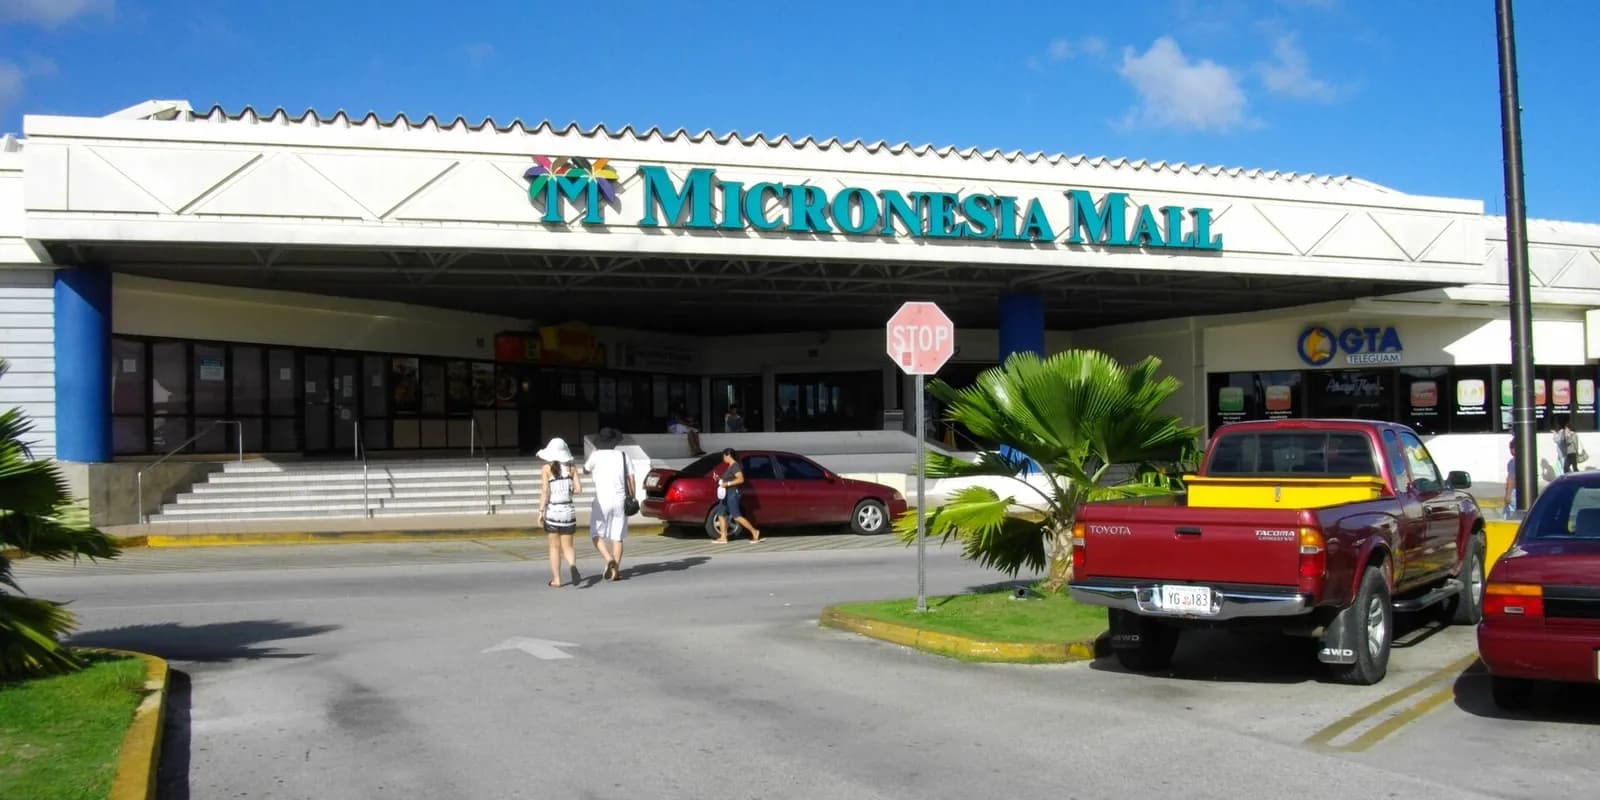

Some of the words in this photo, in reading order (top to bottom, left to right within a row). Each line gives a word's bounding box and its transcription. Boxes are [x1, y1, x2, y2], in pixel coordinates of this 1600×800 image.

[638, 164, 1055, 242] MICRONESIA
[1064, 189, 1223, 250] MALL
[893, 325, 949, 352] STOP
[1339, 327, 1403, 354] GTA
[1347, 353, 1400, 364] TELEGUAM
[1089, 525, 1131, 535] TOYOTA
[1168, 592, 1180, 605] YG
[1192, 594, 1208, 607] 183
[1321, 648, 1354, 657] 4WD
